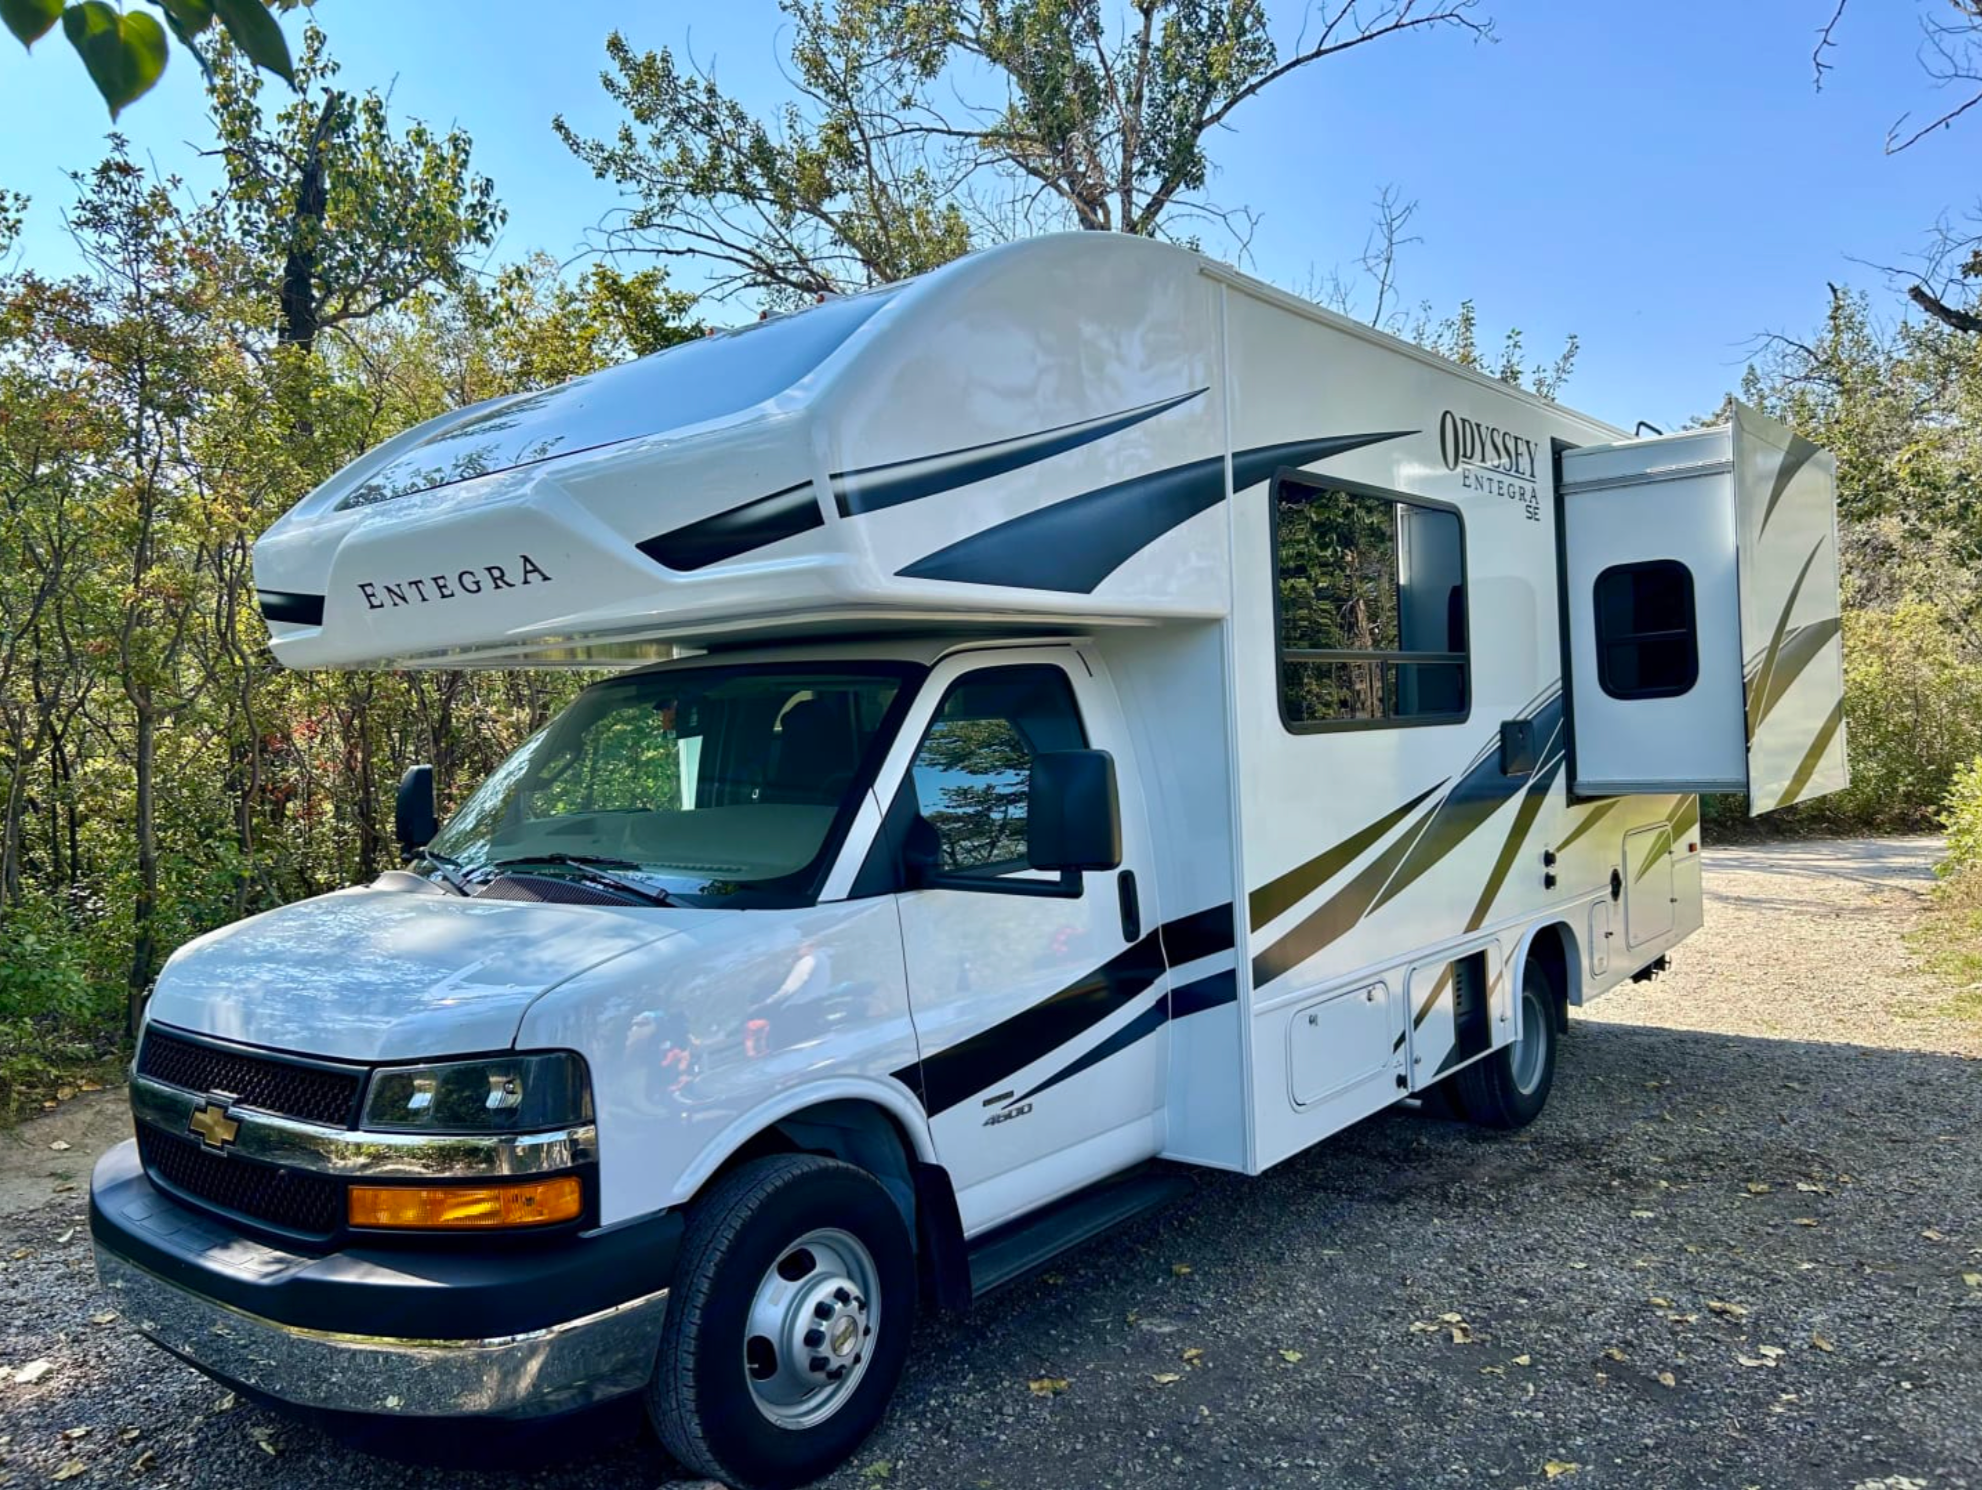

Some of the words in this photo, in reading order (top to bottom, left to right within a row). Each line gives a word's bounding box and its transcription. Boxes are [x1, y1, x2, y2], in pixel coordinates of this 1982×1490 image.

[1440, 409, 1538, 478] ODYSSEY
[1462, 467, 1539, 504] ENTEGRA
[1525, 504, 1540, 521] SE
[357, 554, 553, 609] ENTEGRA
